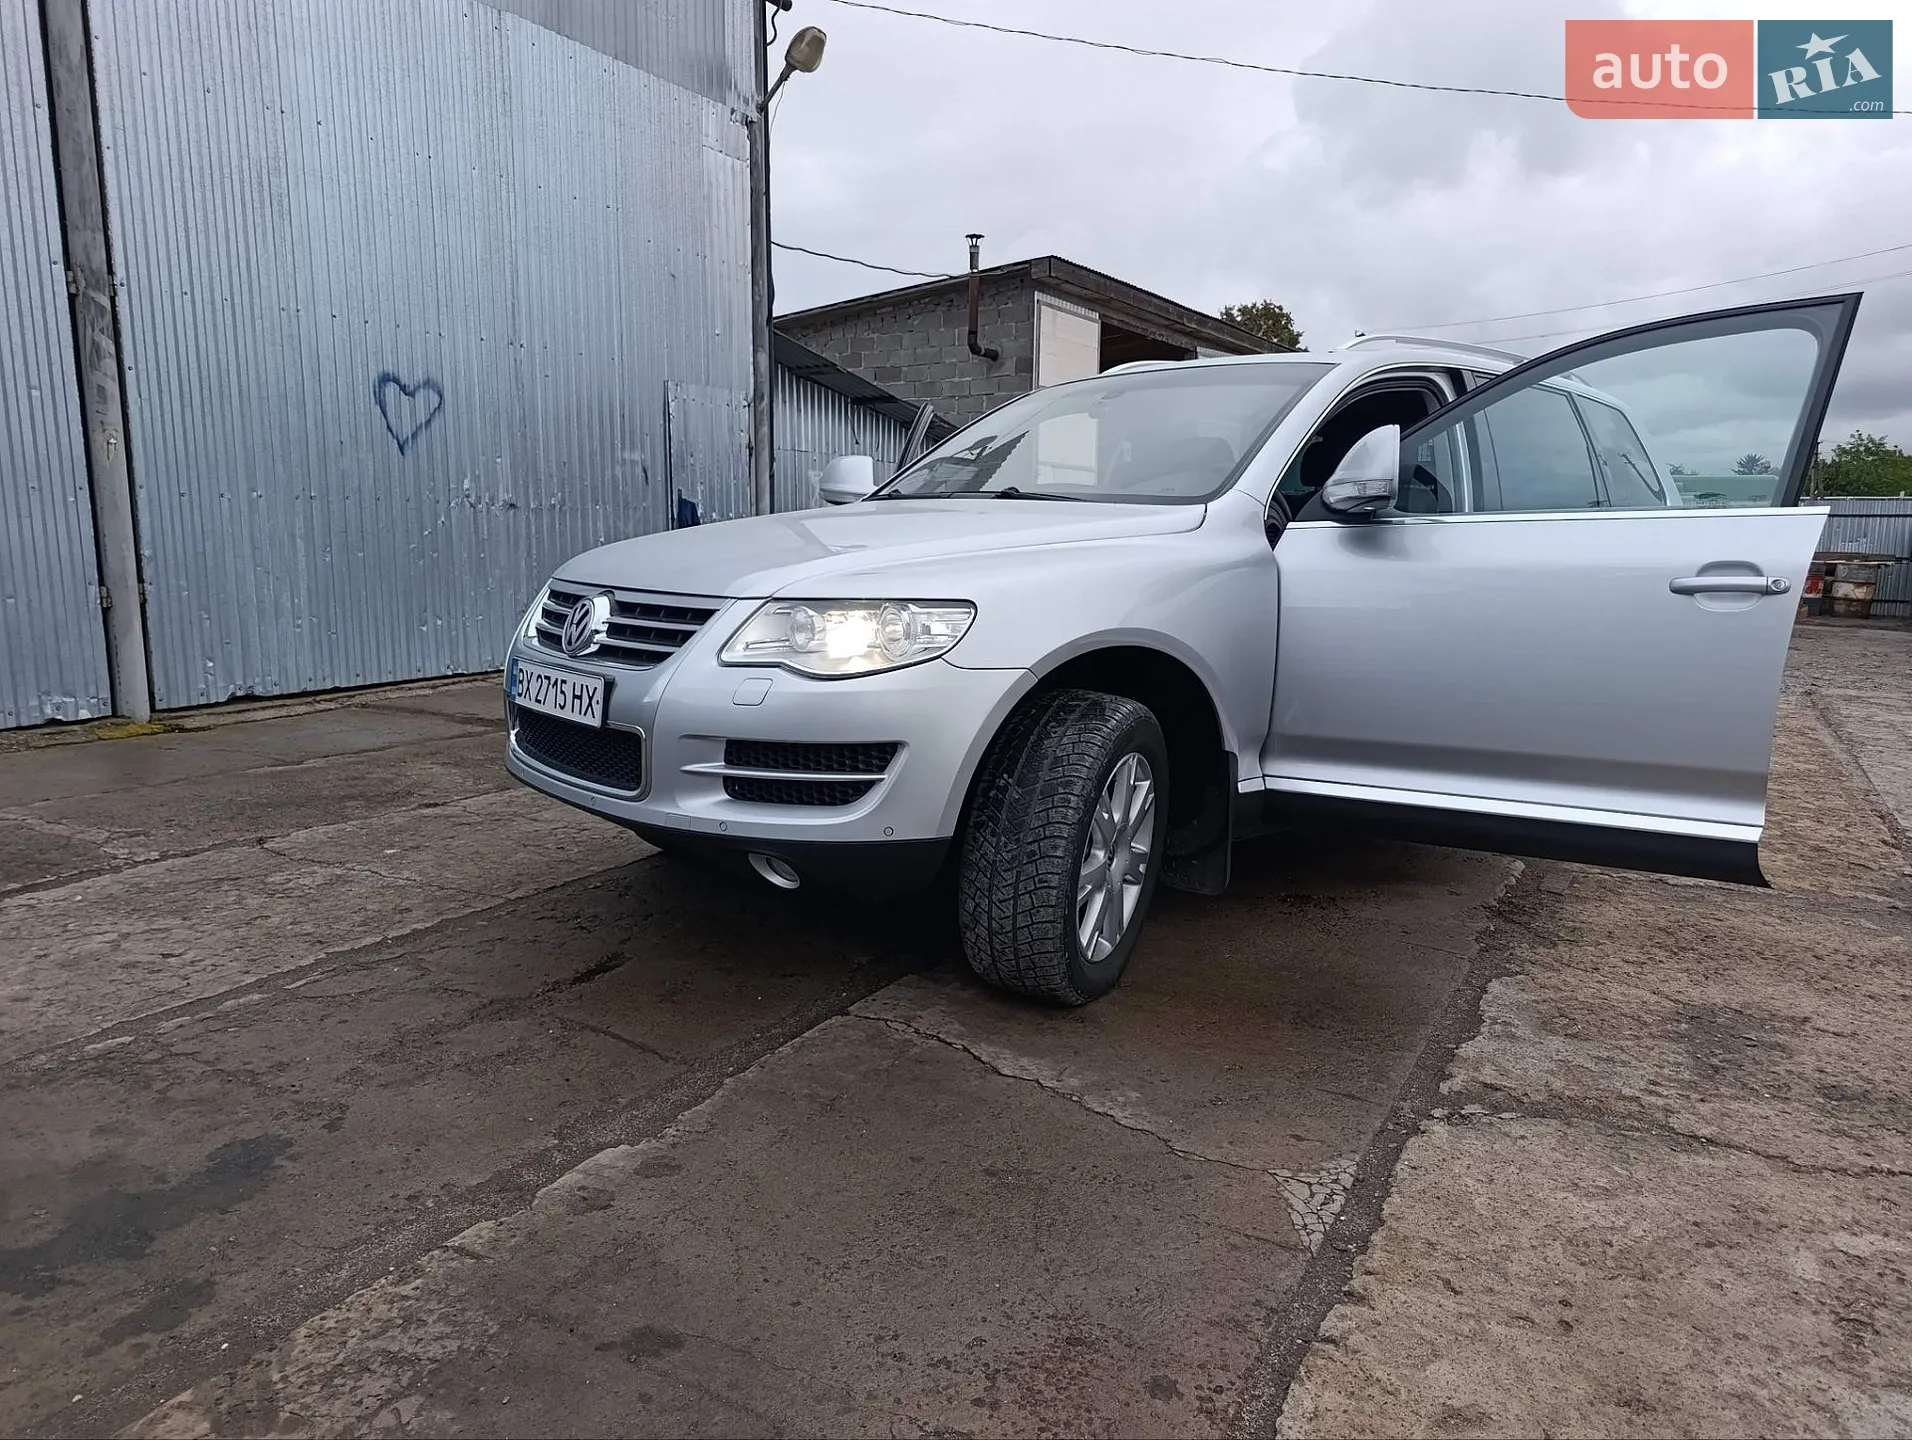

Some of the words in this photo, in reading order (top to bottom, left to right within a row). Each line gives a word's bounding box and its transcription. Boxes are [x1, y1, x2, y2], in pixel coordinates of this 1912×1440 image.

[517, 667, 533, 702] BX
[534, 674, 567, 710] 2715
[571, 681, 598, 719] HX
